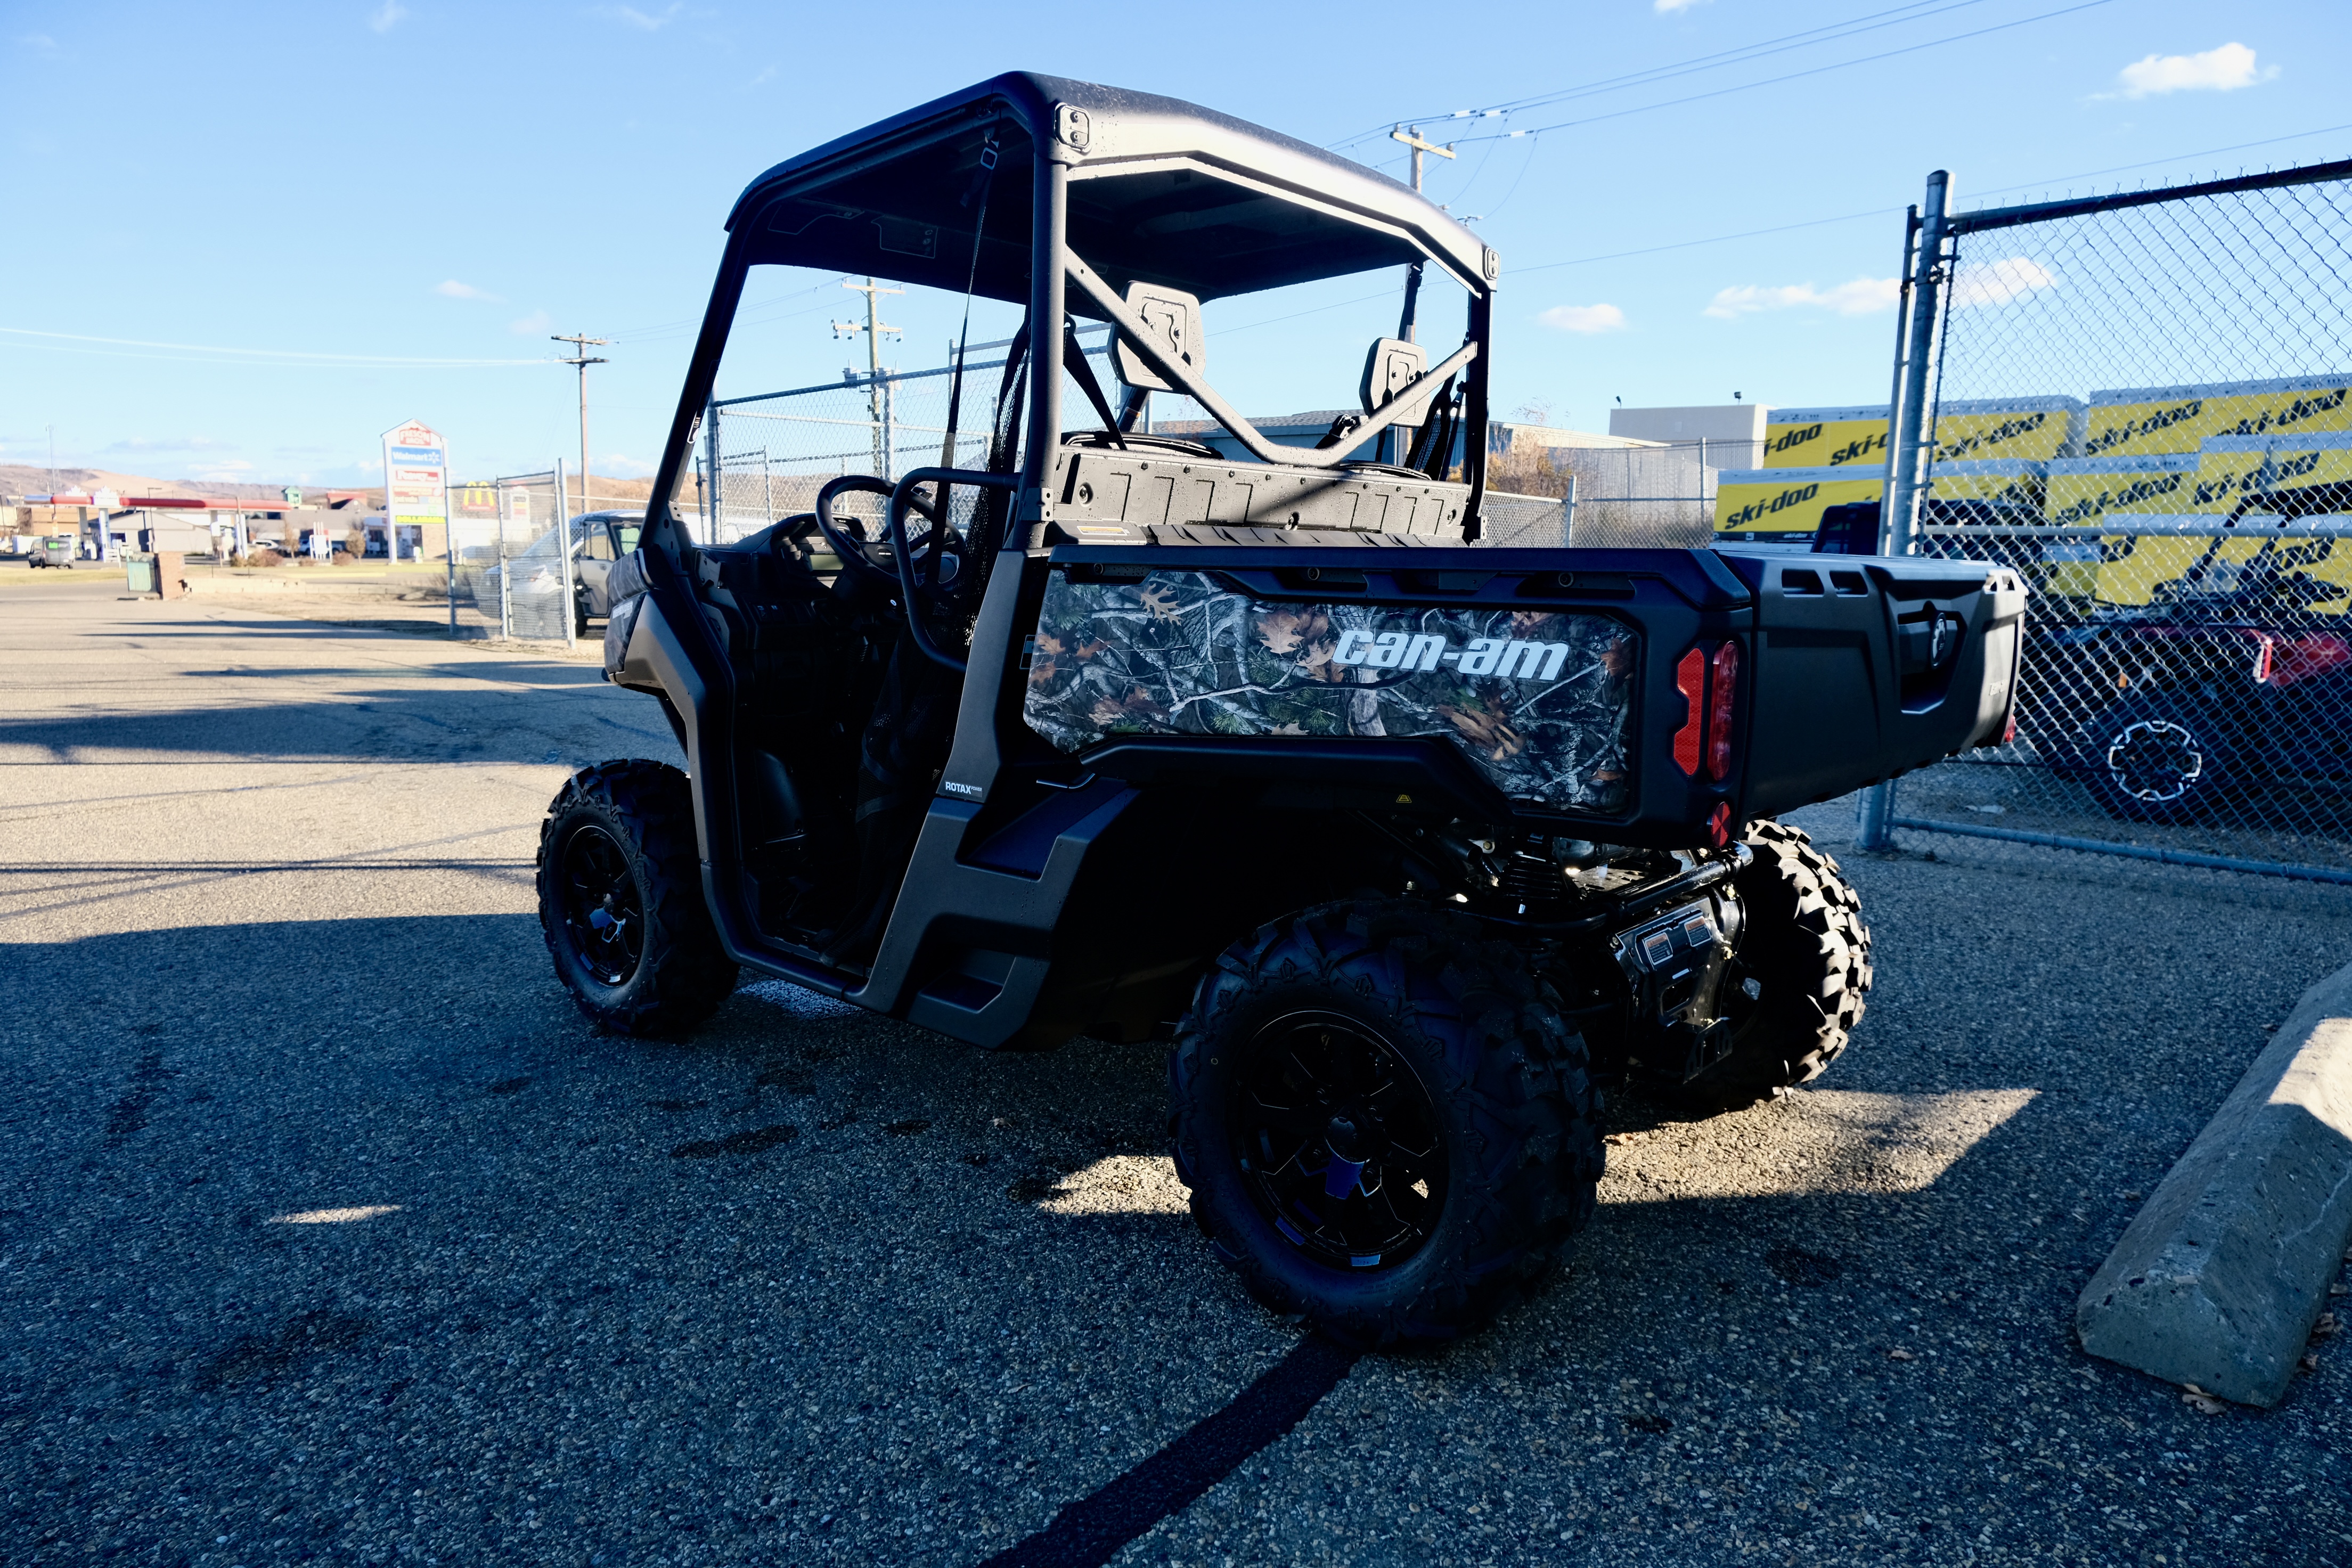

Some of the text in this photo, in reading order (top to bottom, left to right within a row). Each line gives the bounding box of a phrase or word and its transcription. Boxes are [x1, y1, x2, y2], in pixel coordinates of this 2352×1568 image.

[1936, 413, 2046, 463] ski-doo
[2086, 400, 2203, 455] ski-doo
[392, 451, 429, 462] Walmart
[1725, 483, 1819, 530] ski-doo
[2054, 472, 2182, 526] ski-doo
[1332, 630, 1570, 681] can-am
[945, 781, 971, 794] ROTAX
